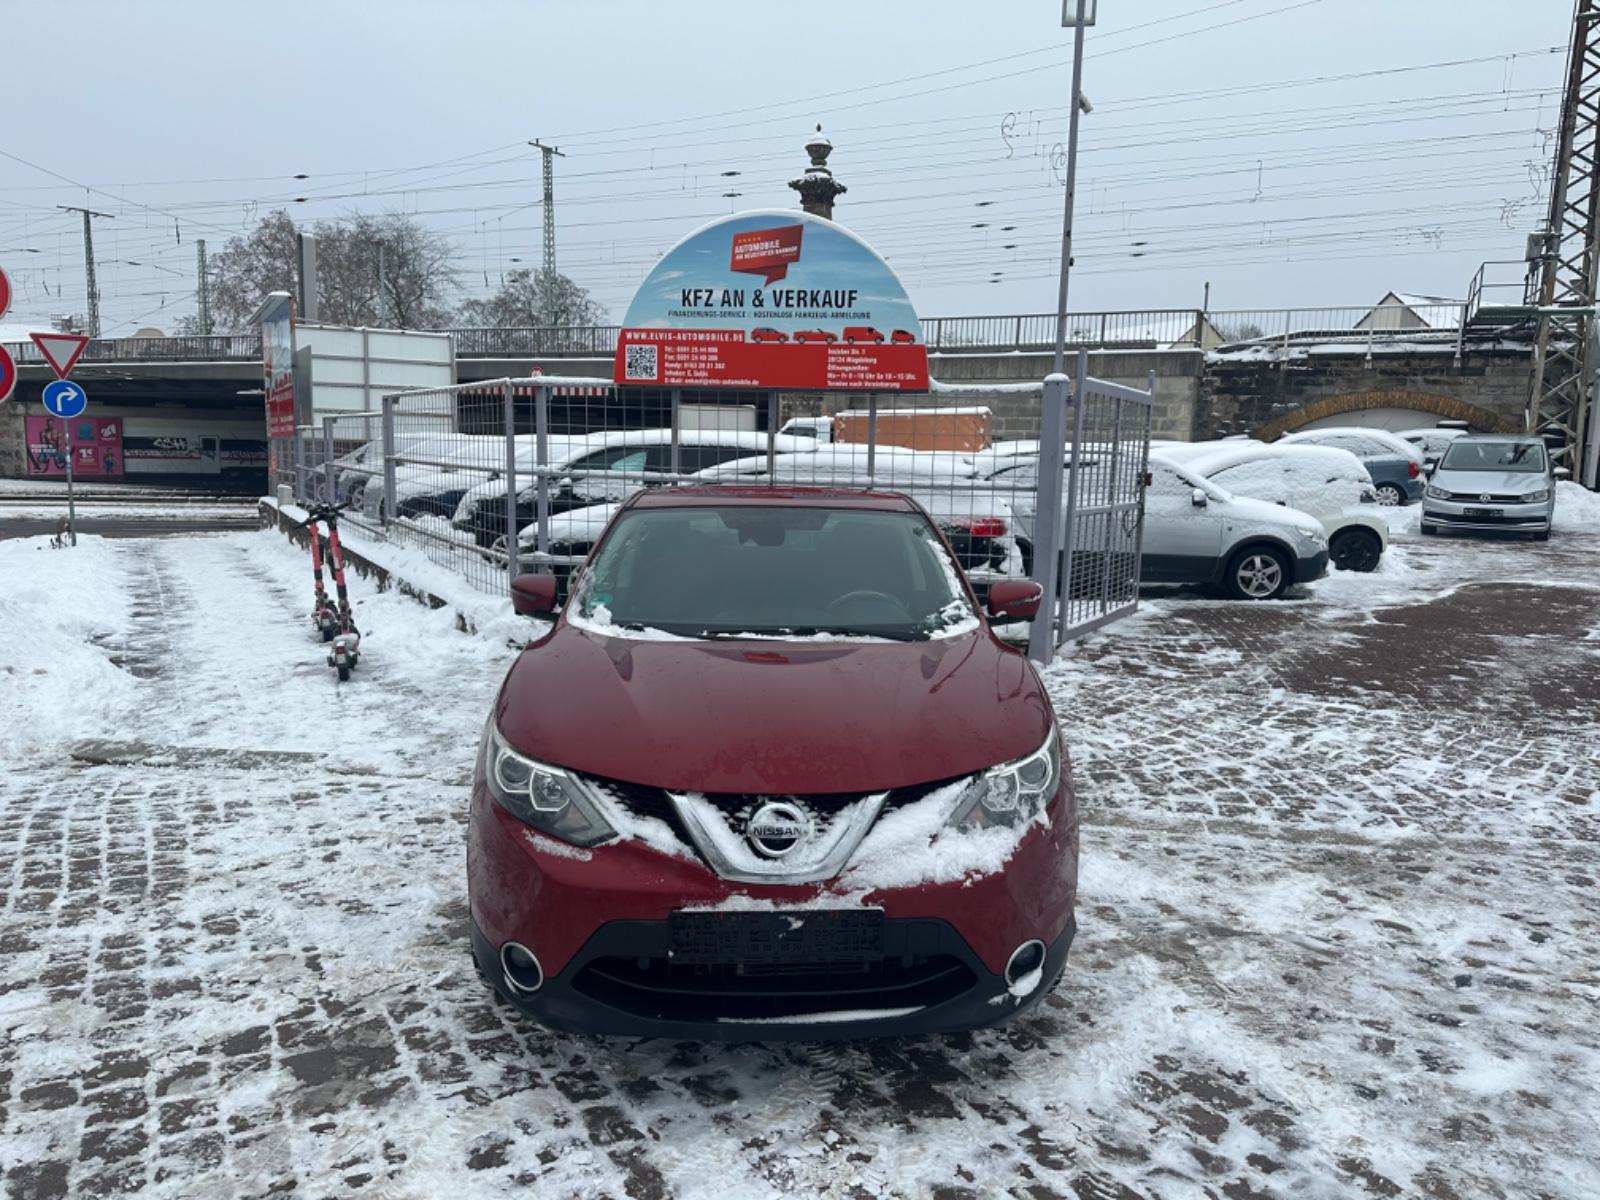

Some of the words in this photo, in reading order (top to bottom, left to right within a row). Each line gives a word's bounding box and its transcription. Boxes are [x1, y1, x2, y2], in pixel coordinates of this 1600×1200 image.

[735, 240, 780, 254] AUTOMOBILE
[681, 288, 713, 307] KFZ
[720, 289, 744, 307] AN
[751, 289, 764, 308] &
[772, 289, 858, 309] VERKAUF
[626, 332, 743, 342] WWW.ELVIS-AUTOMOBILE.DE
[846, 357, 877, 365] Magdeburg
[753, 826, 802, 837] NISSAN
